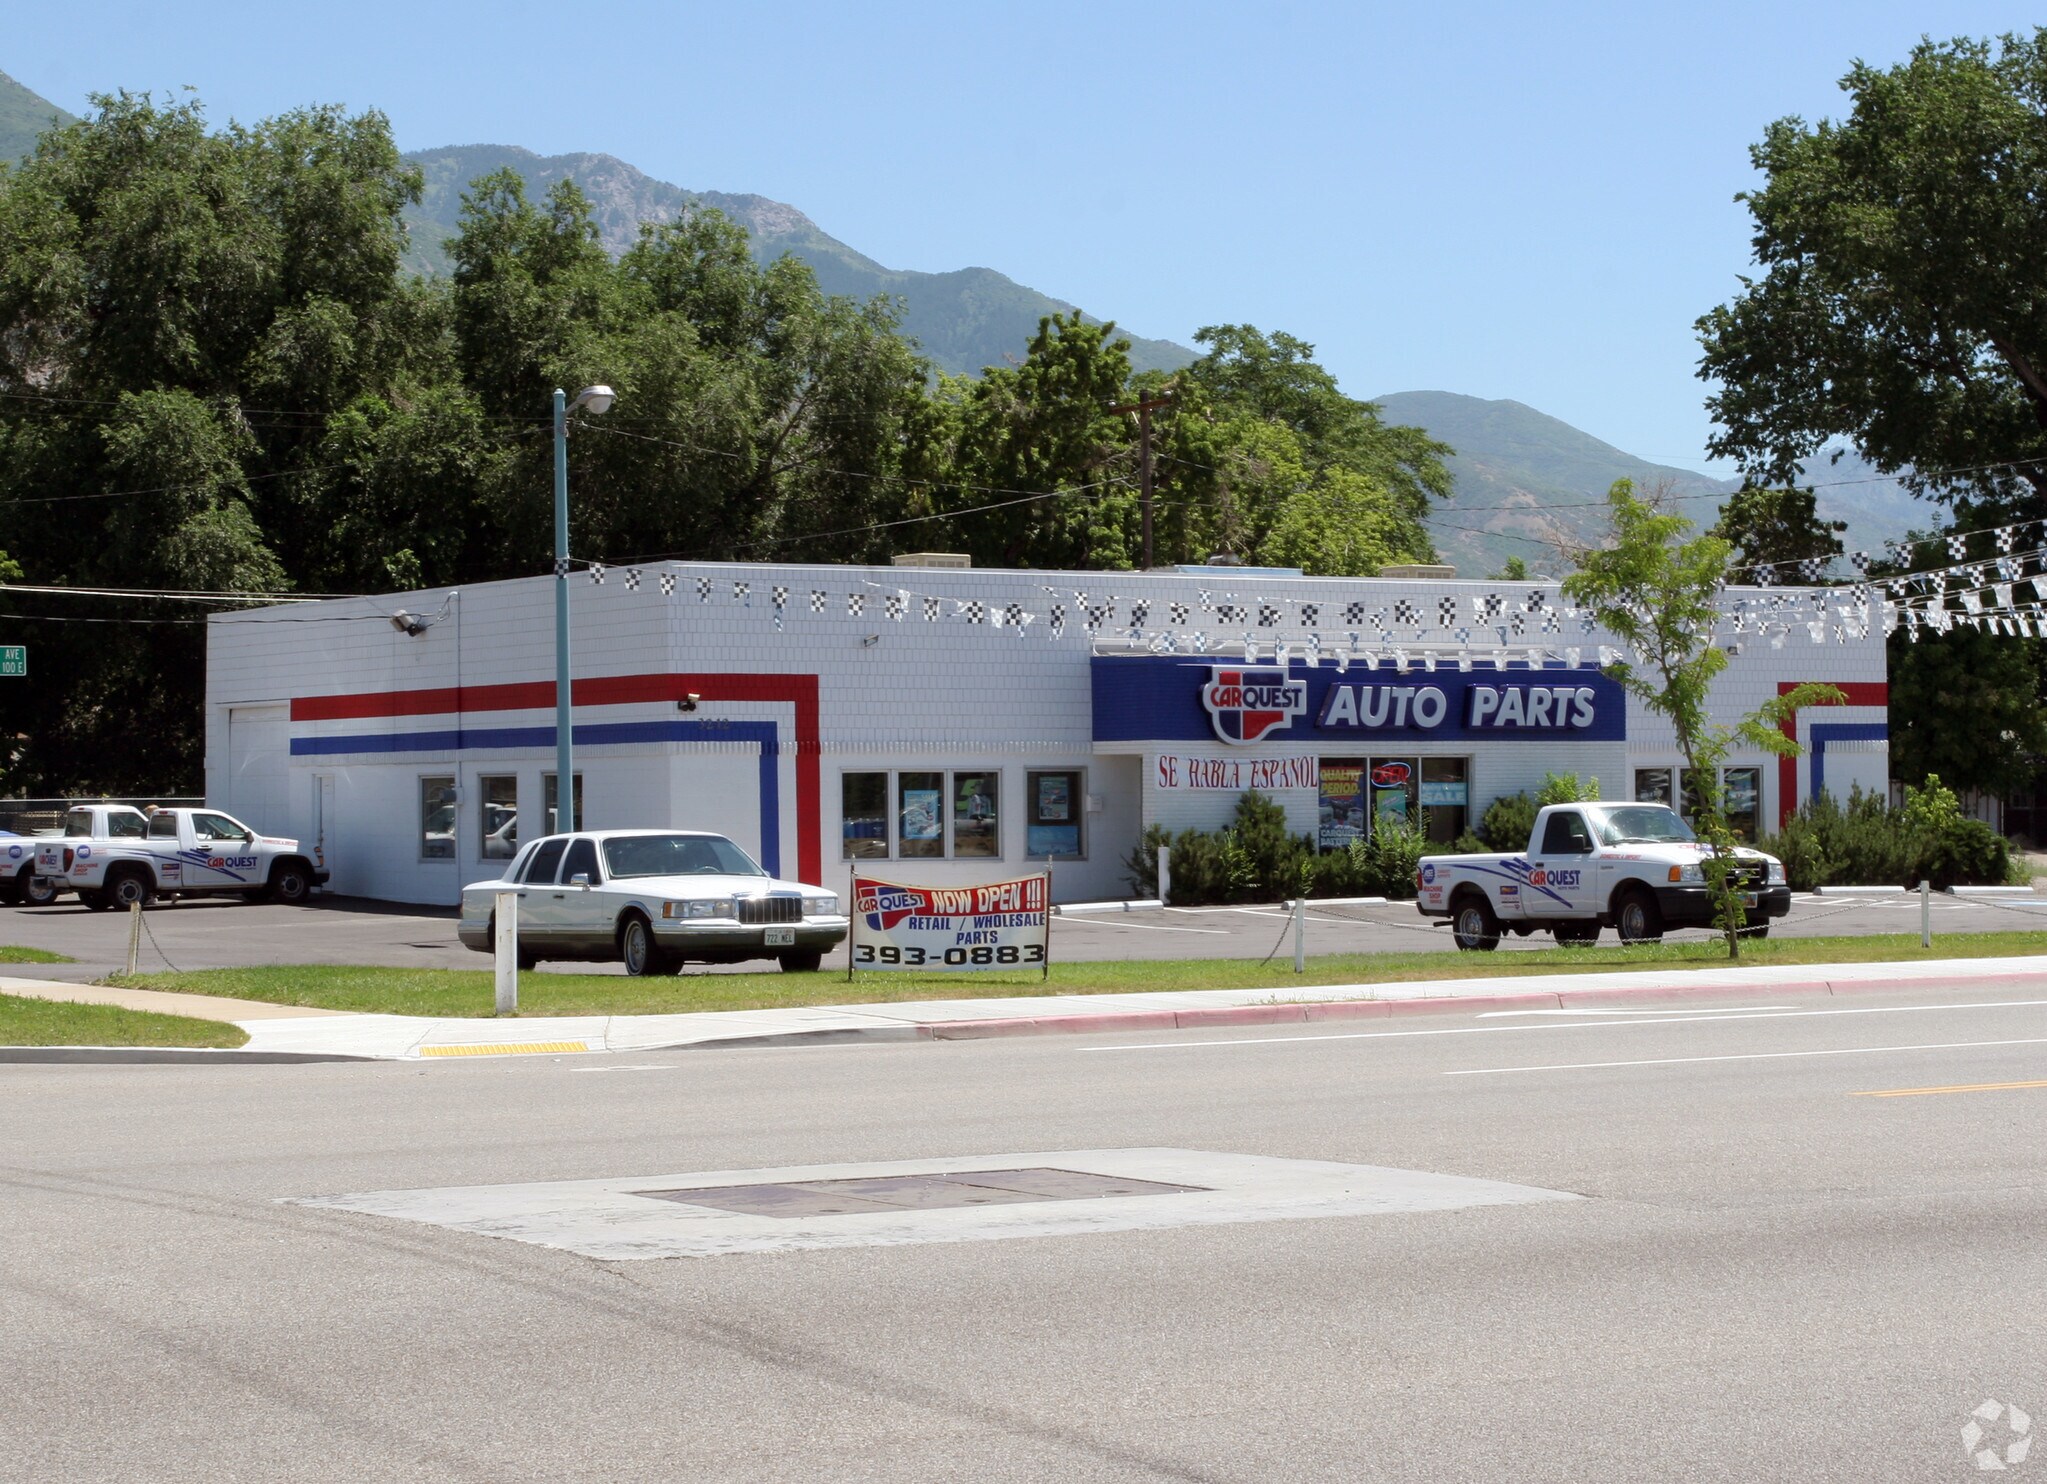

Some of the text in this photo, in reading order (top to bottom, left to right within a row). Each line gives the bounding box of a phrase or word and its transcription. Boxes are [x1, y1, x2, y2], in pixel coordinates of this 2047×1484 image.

[5, 649, 20, 659] AVE
[2, 661, 23, 672] 100 E
[1324, 685, 1447, 728] AUTO
[1471, 687, 1596, 728] PARTS
[1159, 755, 1178, 788] SE
[1188, 757, 1240, 788] HABLA
[1320, 769, 1361, 782] QUALITY
[1372, 765, 1409, 783] OPEN
[1320, 782, 1361, 795] PERIOD.
[1422, 791, 1466, 802] SALE
[931, 879, 1041, 914] NOW OPEN !!!
[908, 916, 951, 930] RETAIL
[973, 912, 1045, 929] WHOLESALE
[956, 930, 998, 945] PARTS
[855, 944, 1044, 966] 393-0883
